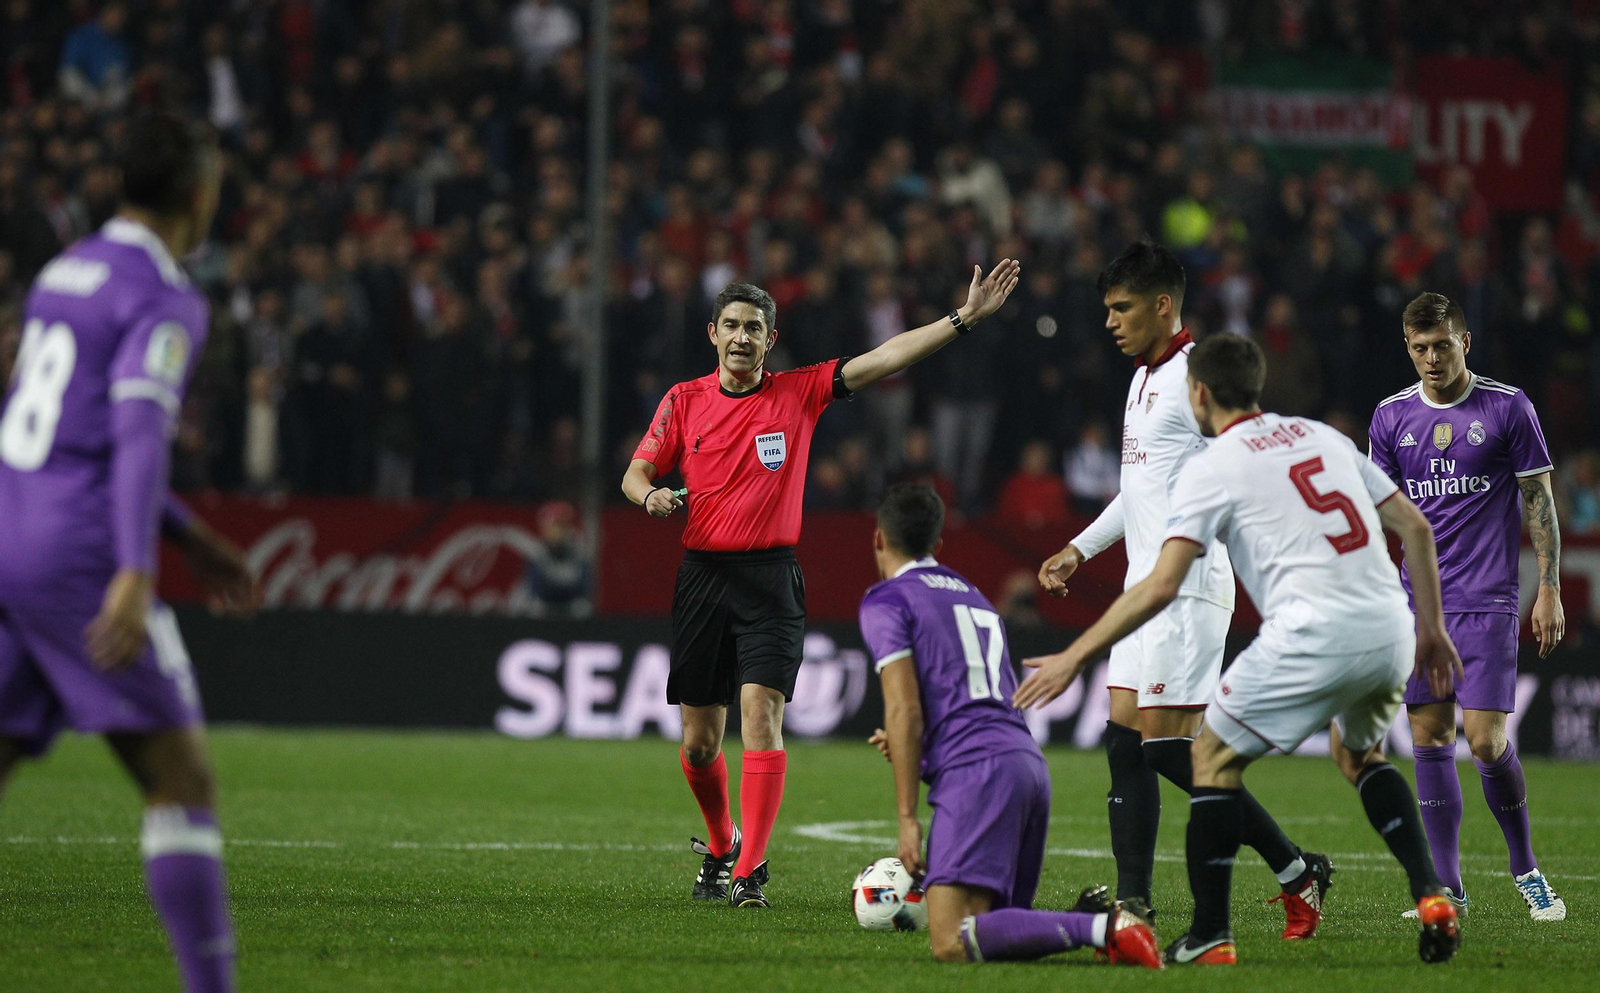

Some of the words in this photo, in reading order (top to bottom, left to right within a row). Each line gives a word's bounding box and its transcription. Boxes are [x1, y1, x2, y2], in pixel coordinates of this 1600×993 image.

[757, 434, 783, 443] REFEREE
[763, 448, 781, 457] FIFA
[1429, 457, 1456, 475] Fly
[1405, 473, 1491, 500] Emirates
[1289, 455, 1369, 555] 5
[918, 573, 970, 593] LUCAS
[953, 603, 1004, 702] 17
